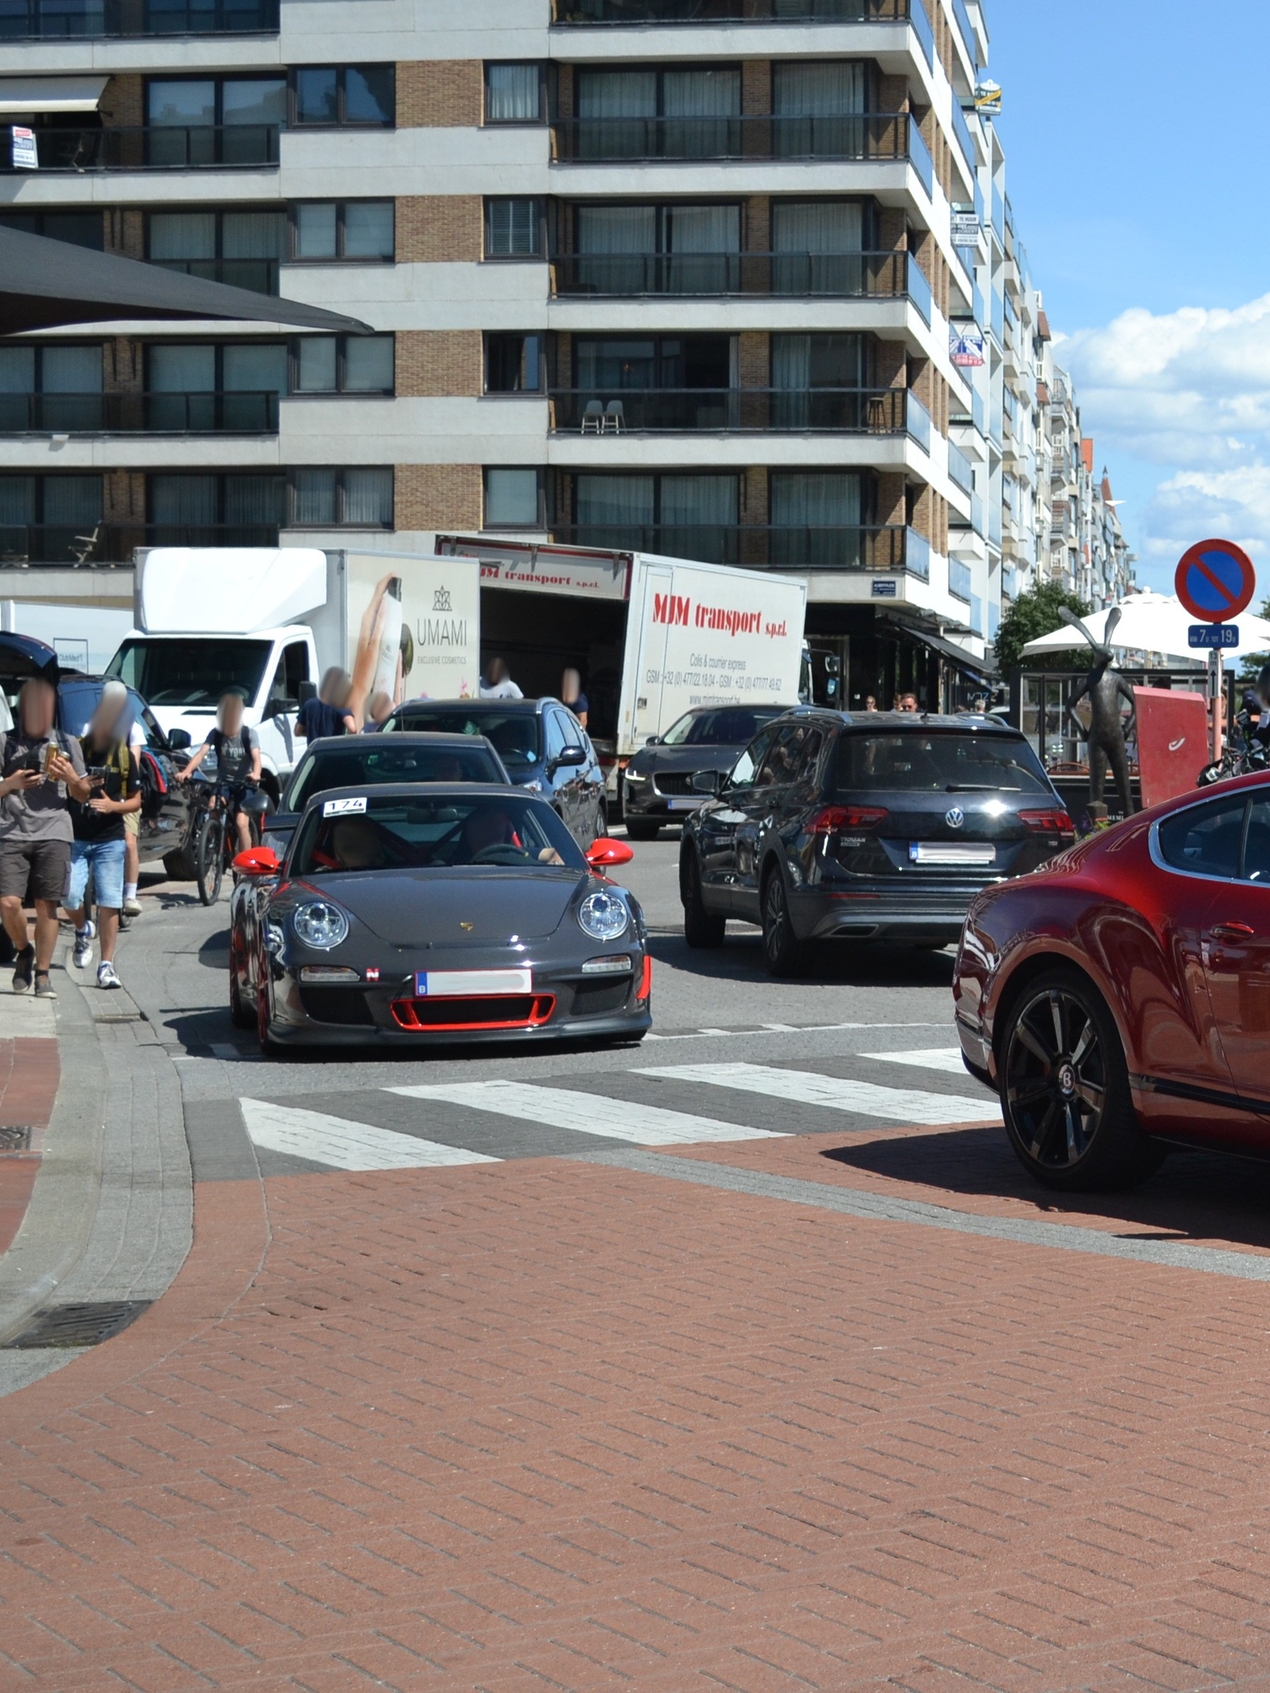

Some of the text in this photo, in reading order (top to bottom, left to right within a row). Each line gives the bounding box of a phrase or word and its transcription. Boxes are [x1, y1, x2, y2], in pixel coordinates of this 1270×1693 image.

[505, 570, 572, 585] transport
[653, 592, 690, 627] MJM
[695, 603, 762, 637] transport
[417, 618, 467, 647] UMAMI
[417, 656, 467, 665] EXCLUSIVE COSMETICS
[689, 652, 703, 667] Colis
[728, 659, 747, 672] express
[646, 669, 661, 684] GSM
[719, 674, 732, 688] GSM
[329, 799, 363, 811] 174
